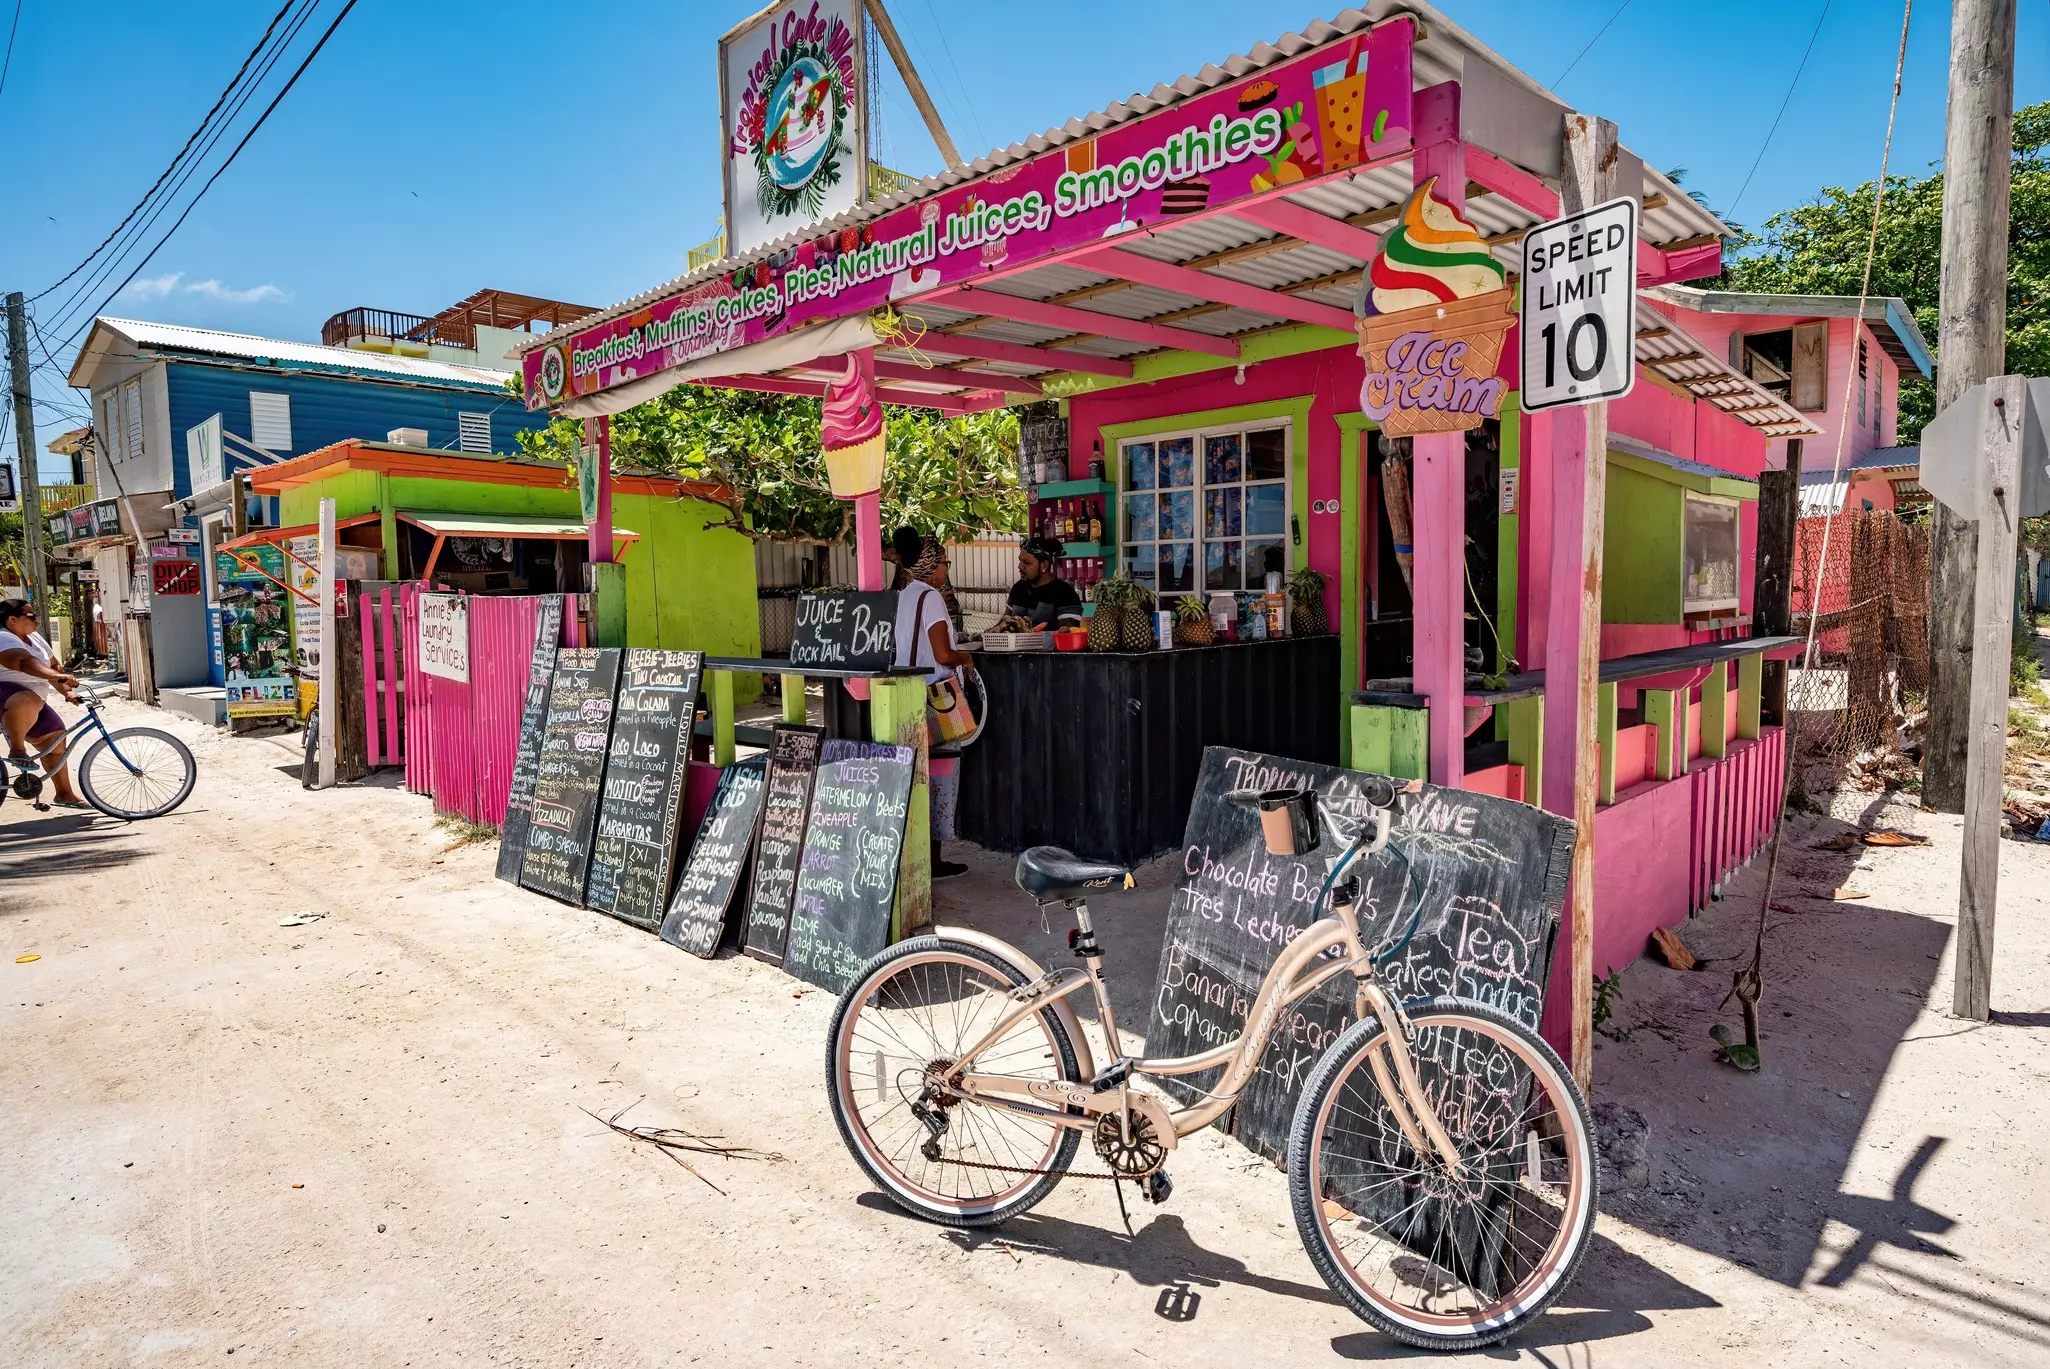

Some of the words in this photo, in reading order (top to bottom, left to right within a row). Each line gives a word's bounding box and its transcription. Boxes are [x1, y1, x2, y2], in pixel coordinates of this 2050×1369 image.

[730, 22, 777, 160] Tropical
[782, 1, 827, 49] Cake
[827, 19, 855, 109] Wave
[574, 331, 644, 377] Breakfast,
[646, 307, 713, 351] Muffins,
[716, 284, 783, 328] Cakes,
[939, 190, 1052, 256] Juices,
[1056, 108, 1284, 217] Smoothies
[1530, 223, 1625, 273] SPEED
[1539, 267, 1612, 311] LIMIT
[1385, 330, 1469, 377] Ice
[1541, 312, 1608, 388] 10
[155, 564, 197, 579] DIVE
[156, 579, 199, 594] SHOP
[797, 595, 845, 627] JUICE
[850, 604, 892, 656] BAR
[426, 641, 465, 671] Services
[227, 684, 295, 702] BELIZE
[647, 711, 677, 729] Pineapple
[641, 758, 668, 772] Coconut
[843, 742, 866, 762] COLD
[869, 744, 913, 765] PRESSED
[718, 764, 764, 792] ALASKA
[835, 761, 880, 783] JUICES
[604, 778, 641, 801] MOJITO
[715, 788, 746, 811] COLD
[815, 778, 873, 808] WATERMELON
[876, 793, 905, 818] Beets
[636, 805, 661, 821] Coconut
[811, 802, 858, 827] PINEAPPLE
[598, 813, 653, 842] MARGARITAS
[806, 826, 843, 851] ORANGE
[862, 827, 894, 852] CREATE
[555, 835, 584, 857] SPECIAL
[693, 839, 734, 859] BELIKIN
[803, 846, 840, 870] CARROT
[864, 850, 887, 870] YOUR
[686, 857, 740, 877] LIGHTHOUSE
[1184, 845, 1278, 898] Chocolate
[754, 882, 786, 909] Vanilla
[798, 869, 844, 901] CUCUMBER
[860, 870, 886, 889] MIX
[796, 891, 826, 916] APPLE
[791, 912, 819, 936] LIME
[797, 935, 812, 951] add
[833, 941, 843, 958] of
[844, 947, 869, 968] Ginge
[1450, 907, 1517, 975] Tea
[794, 951, 808, 964] add
[813, 954, 830, 973] Chia
[1164, 943, 1250, 1023] Banana
[1406, 1026, 1508, 1093] offee
